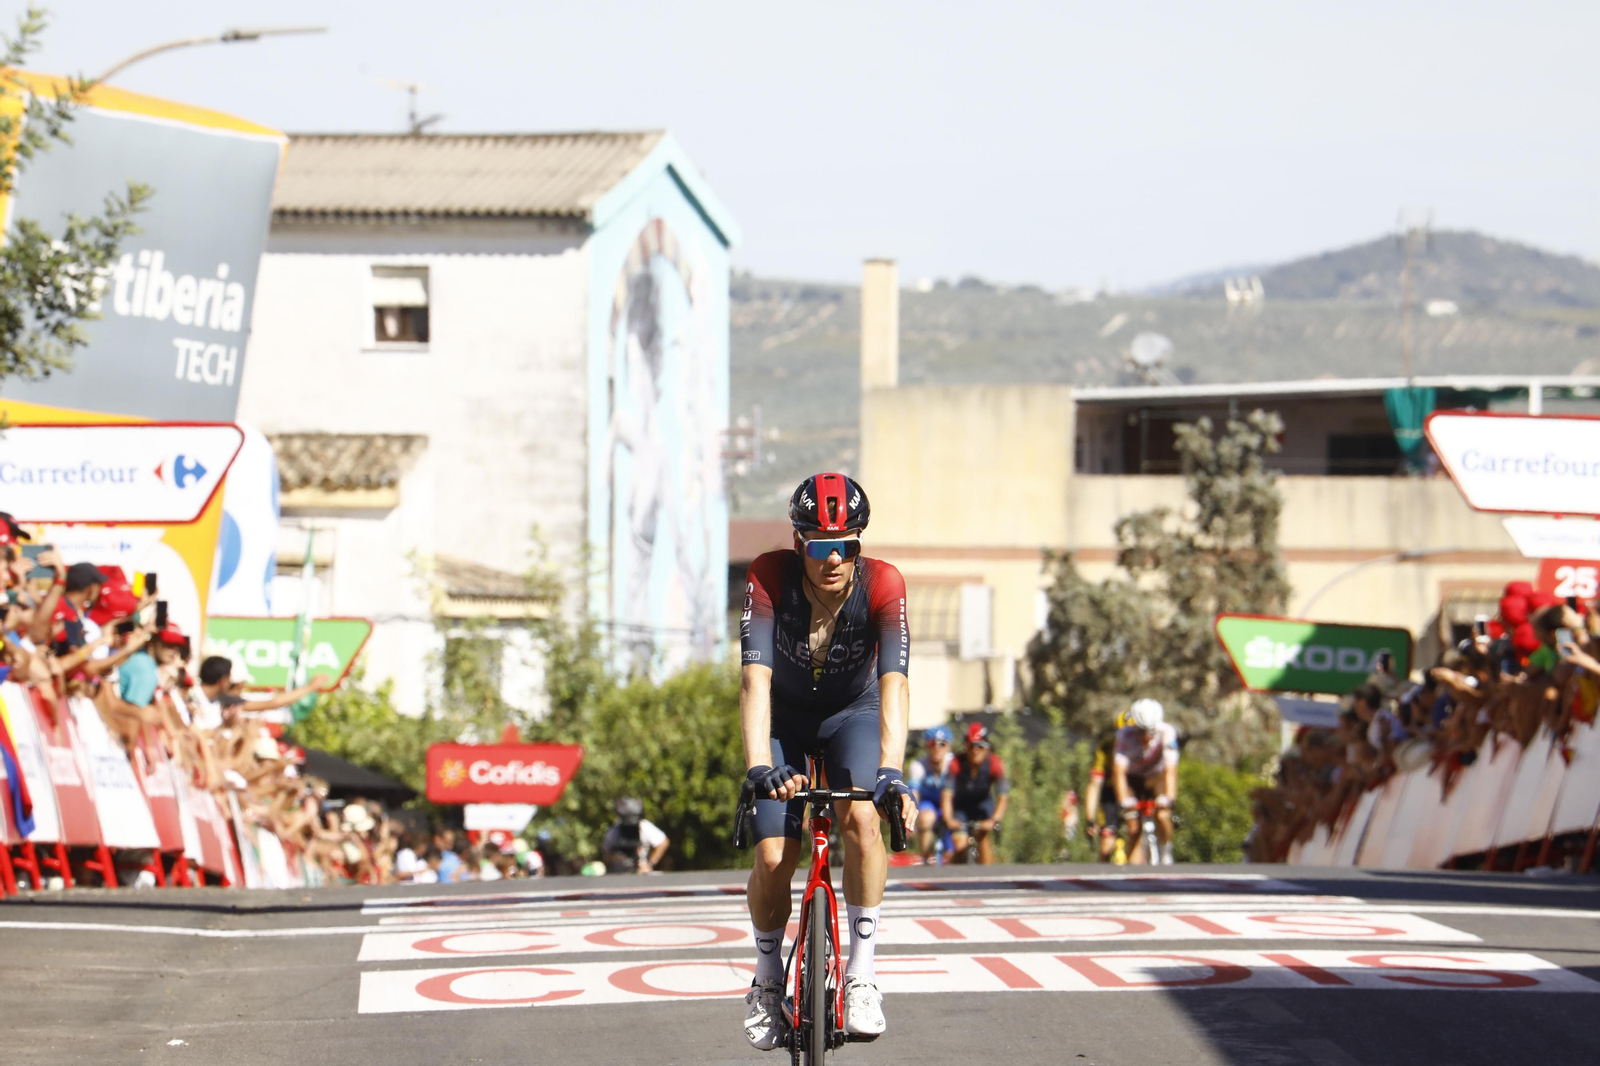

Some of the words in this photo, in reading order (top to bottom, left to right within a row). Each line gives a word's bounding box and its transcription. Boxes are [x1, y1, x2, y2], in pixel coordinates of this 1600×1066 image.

[172, 337, 238, 387] TECH
[0, 460, 138, 483] Carrefour
[1460, 447, 1600, 477] Carrefour
[1554, 565, 1598, 599] 25
[740, 581, 754, 640] INEOS
[776, 624, 865, 663] INEOS
[899, 597, 908, 667] GRENADIER
[207, 637, 341, 669] KODA
[469, 759, 561, 787] Cofidis
[411, 914, 1408, 954] COIDIS
